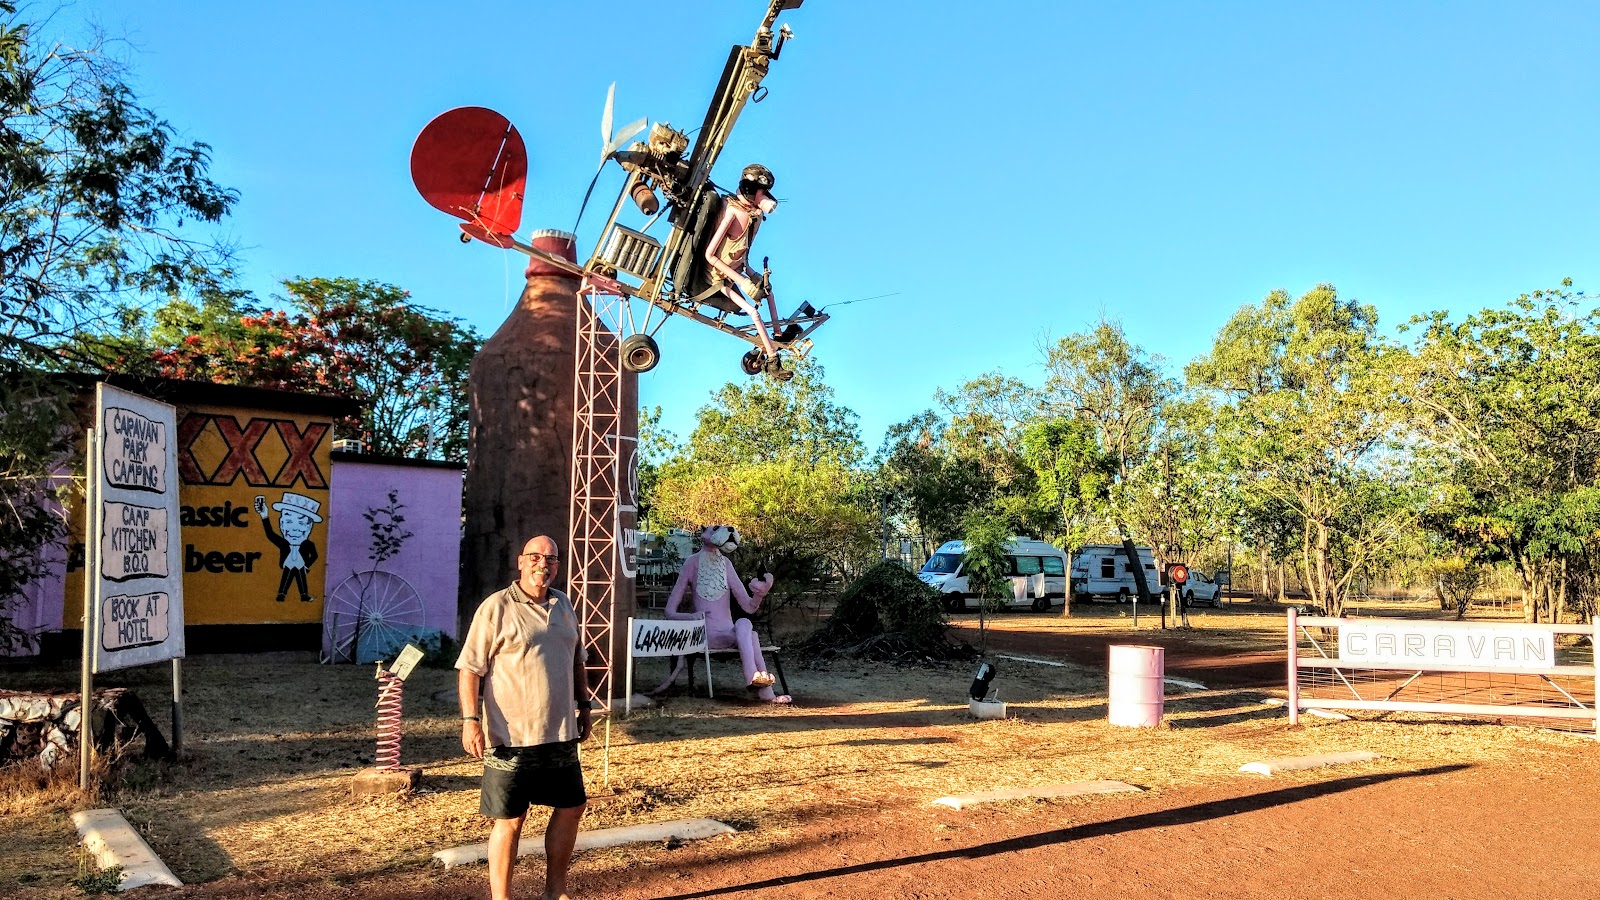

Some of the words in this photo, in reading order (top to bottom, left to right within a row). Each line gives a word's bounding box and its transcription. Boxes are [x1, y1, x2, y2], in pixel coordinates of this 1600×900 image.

[113, 412, 159, 445] CARAVAN
[122, 436, 149, 463] PARK
[112, 458, 158, 488] CAMPING
[122, 505, 150, 527] CAMP
[111, 526, 157, 552] KITCHEN
[184, 543, 263, 574] beer
[111, 598, 140, 623] BOOK
[145, 595, 160, 617] AT
[118, 618, 154, 645] HOTEL
[1346, 632, 1546, 661] CARAVAN
